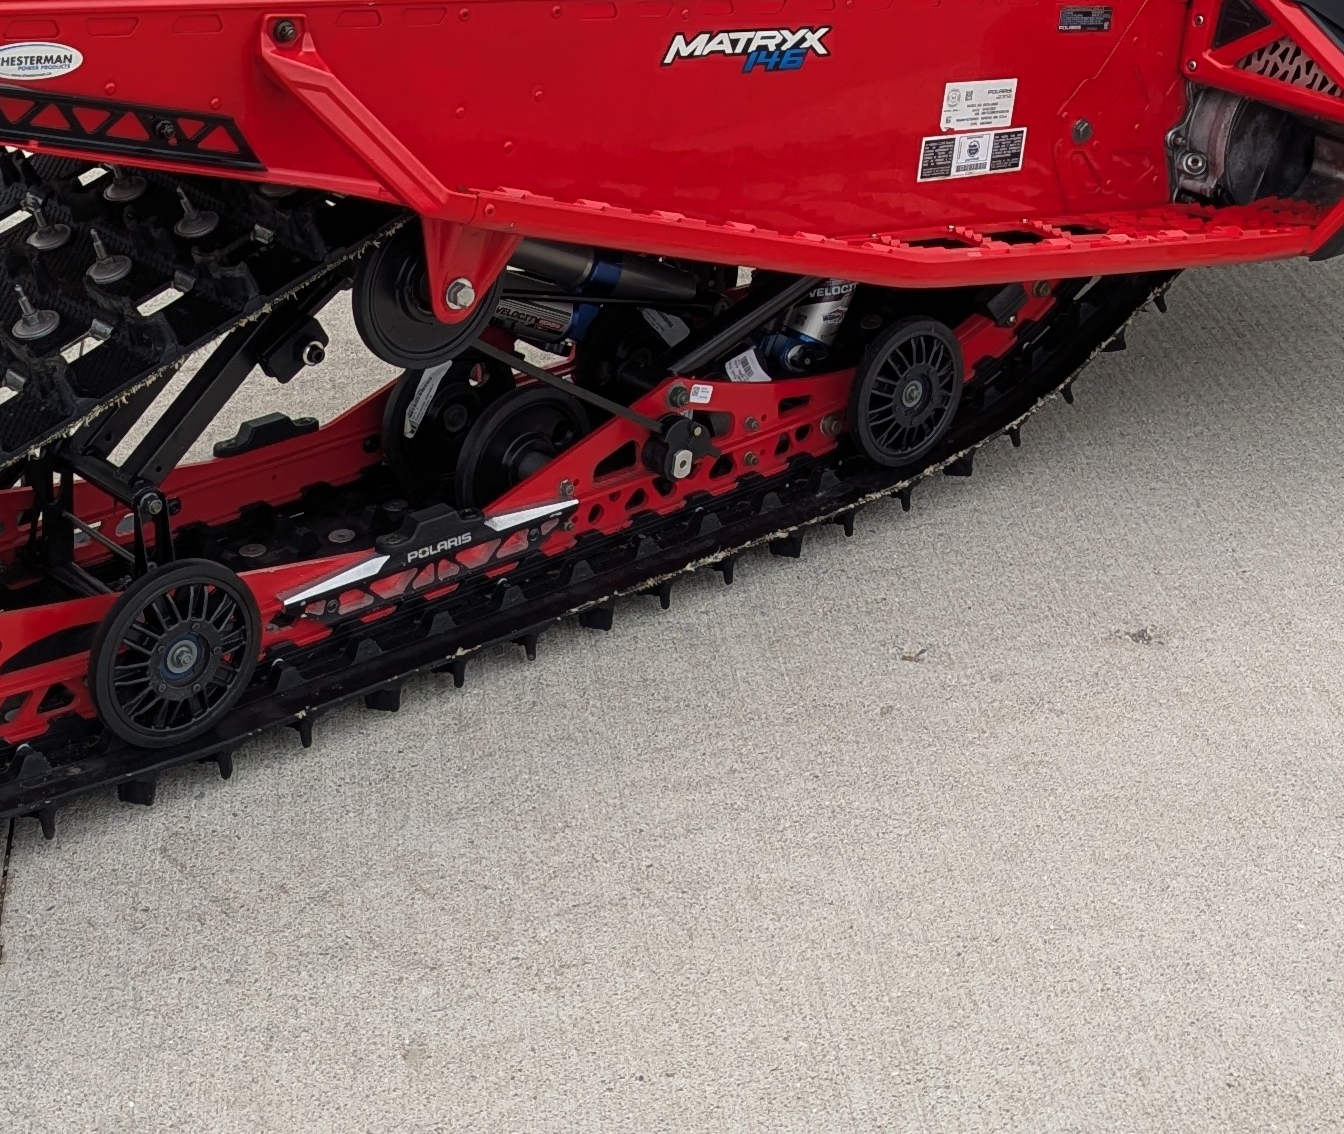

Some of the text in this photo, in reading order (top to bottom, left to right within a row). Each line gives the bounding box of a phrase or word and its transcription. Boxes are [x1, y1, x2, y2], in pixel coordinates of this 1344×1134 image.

[663, 28, 830, 64] MATRYX
[744, 49, 806, 71] 146
[496, 306, 540, 324] VELOCITY
[407, 532, 472, 563] POLARIS
